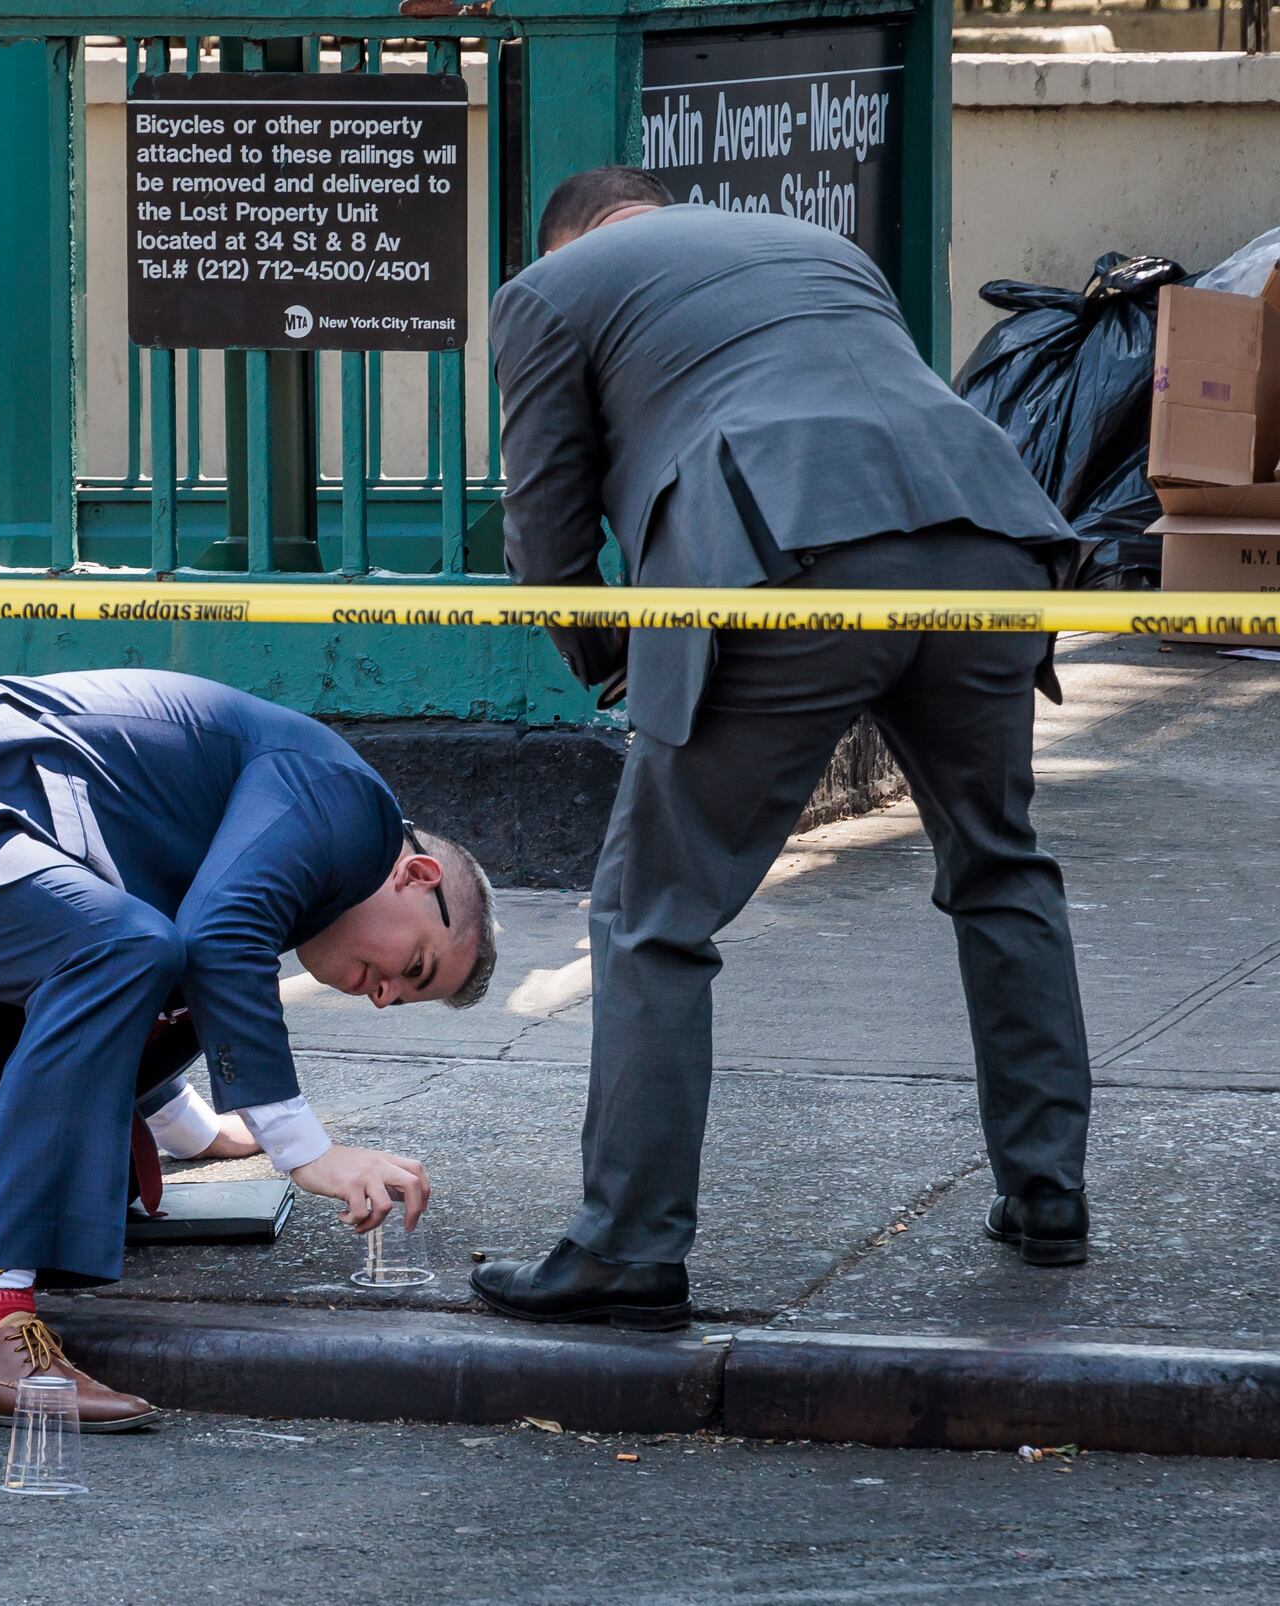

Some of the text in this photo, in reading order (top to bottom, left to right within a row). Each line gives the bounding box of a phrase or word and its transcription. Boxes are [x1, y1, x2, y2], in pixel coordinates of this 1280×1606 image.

[136, 114, 423, 139] Bicycles or other property
[641, 94, 703, 170] anklin
[136, 144, 457, 169] attached to these railings will
[136, 172, 451, 194] be removed and delivered to
[136, 201, 379, 226] the Lost Property Unit
[137, 230, 401, 252] located at 34 St & 8 Av
[137, 257, 430, 283] Tel.# (212) 712-4500/4501
[319, 316, 348, 329] New
[349, 316, 380, 329] York
[381, 316, 409, 332] City
[409, 316, 456, 330] Transit
[1241, 549, 1270, 565] N.Y.
